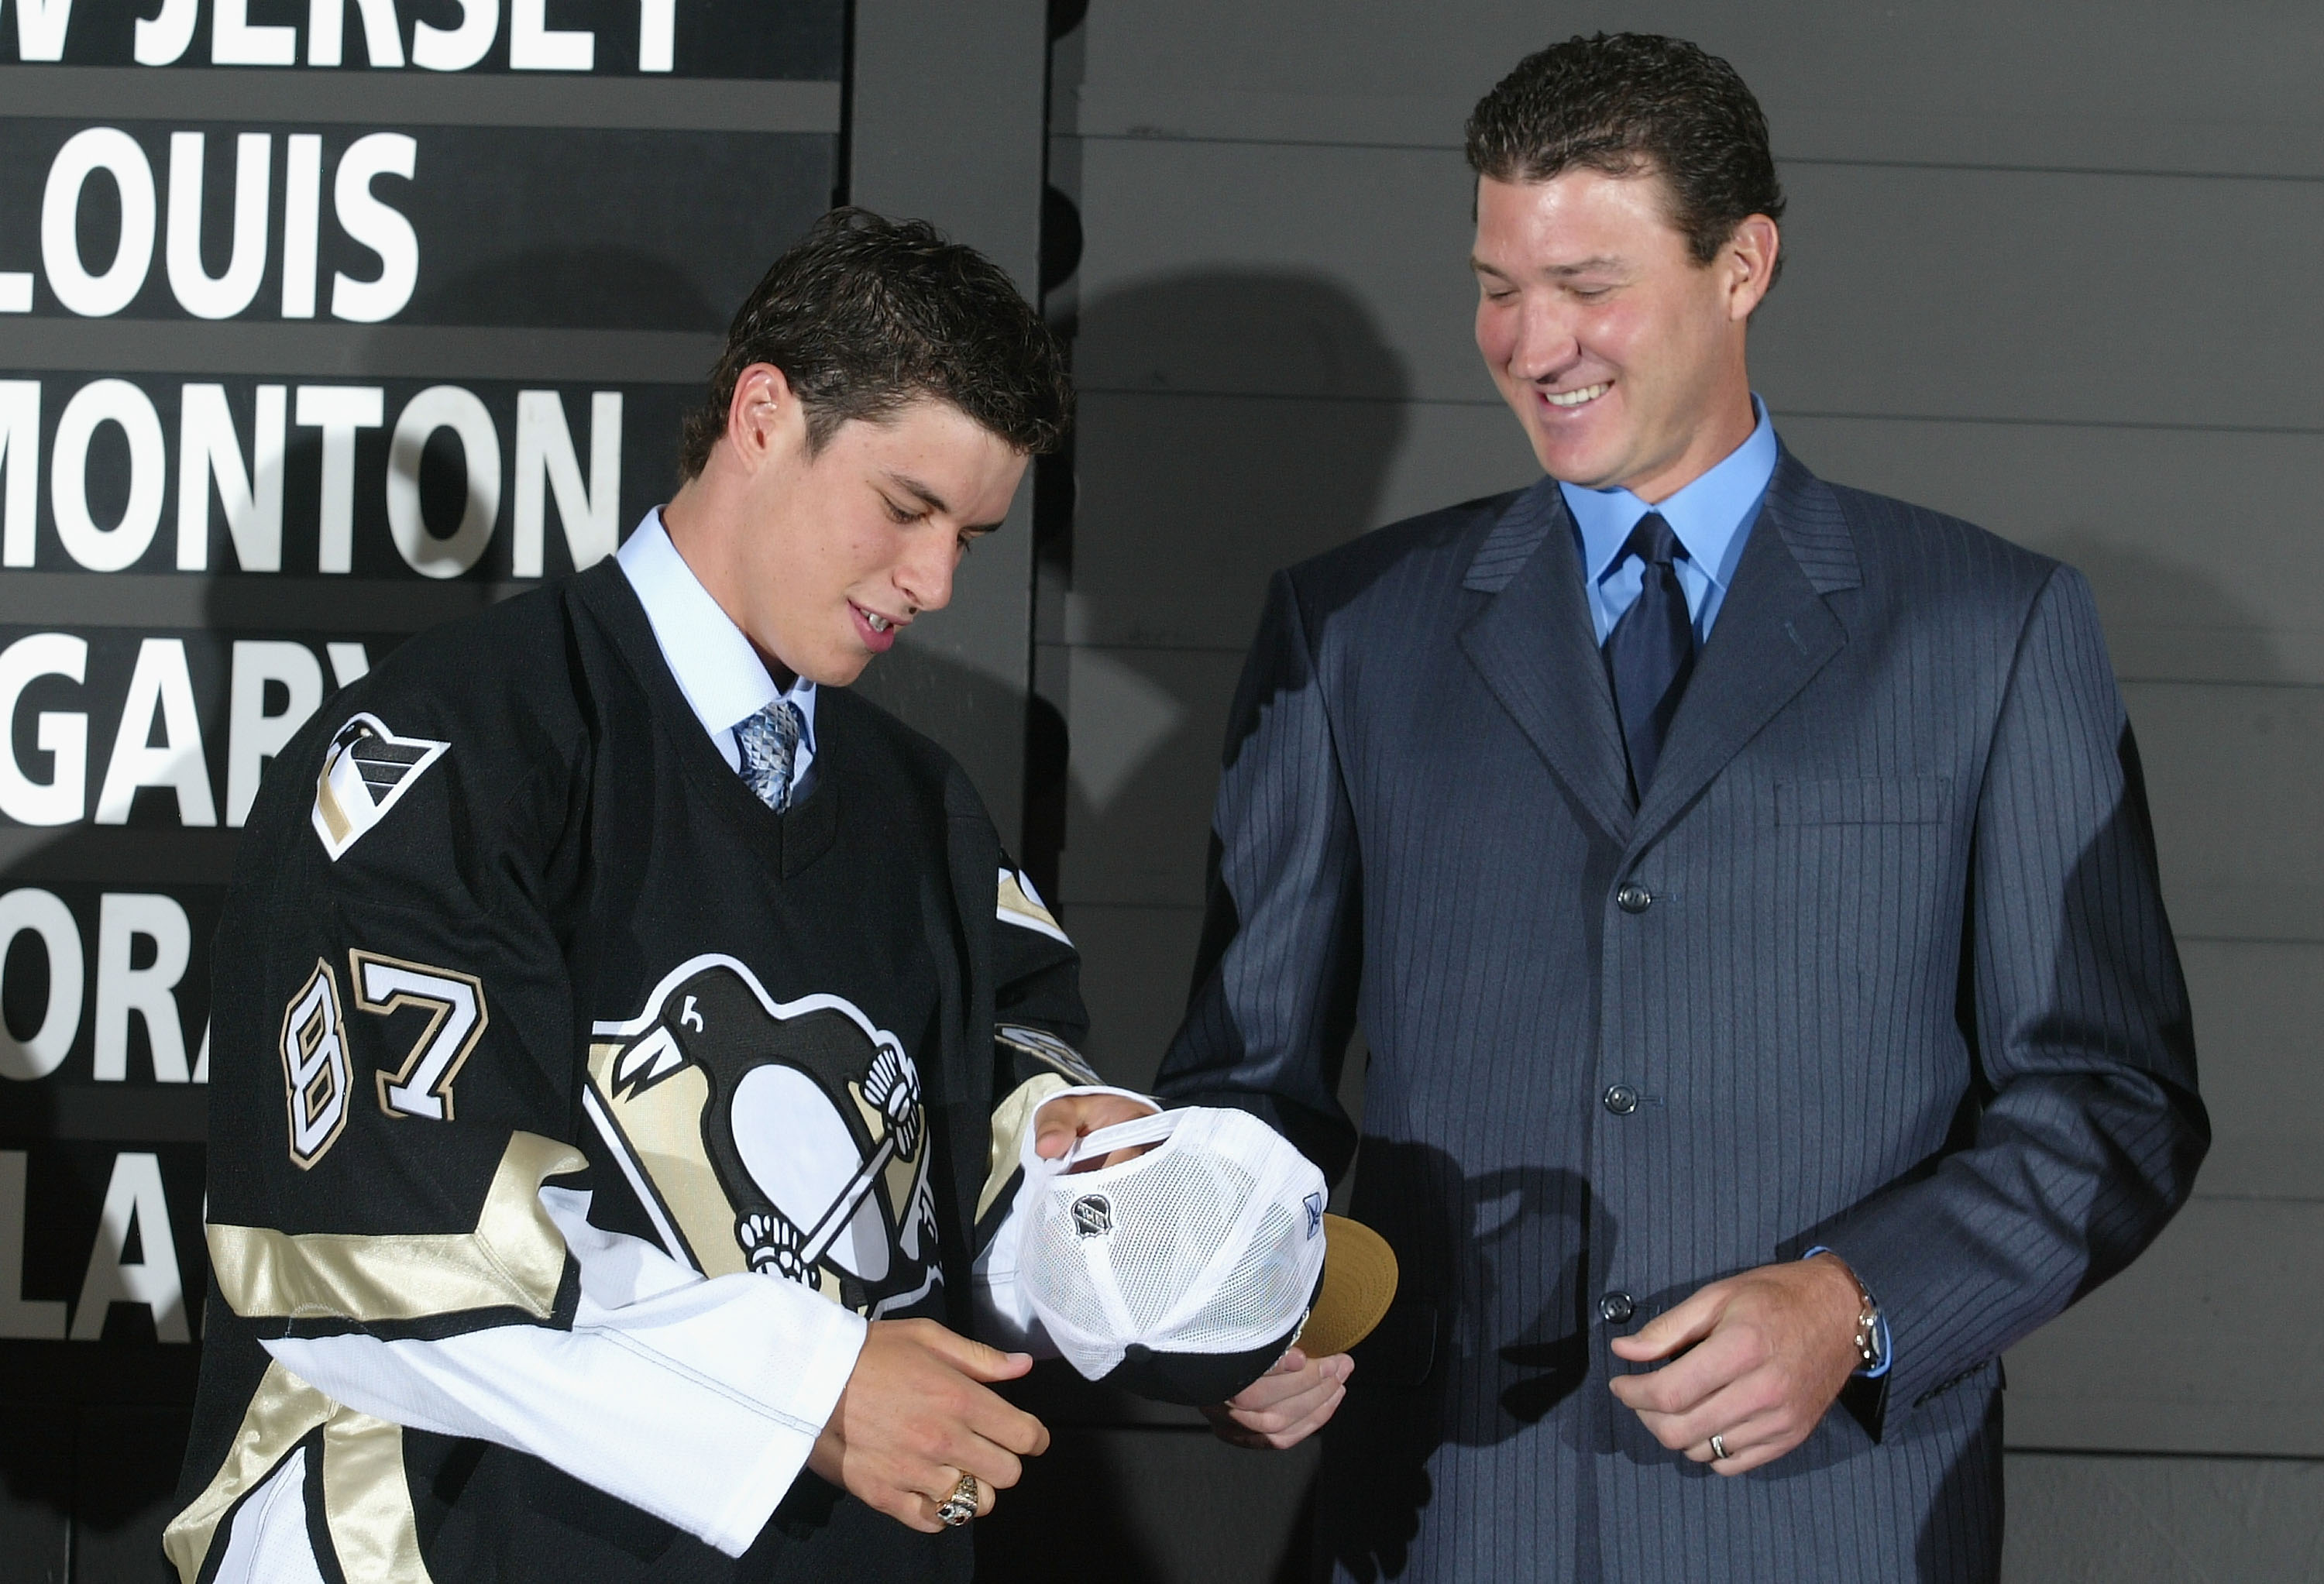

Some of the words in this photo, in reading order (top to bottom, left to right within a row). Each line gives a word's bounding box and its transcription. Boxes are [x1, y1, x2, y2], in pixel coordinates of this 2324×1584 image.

[0, 632, 371, 829] GAR
[0, 888, 211, 1084] OR
[279, 947, 490, 1171] 87
[0, 1149, 208, 1344] LA
